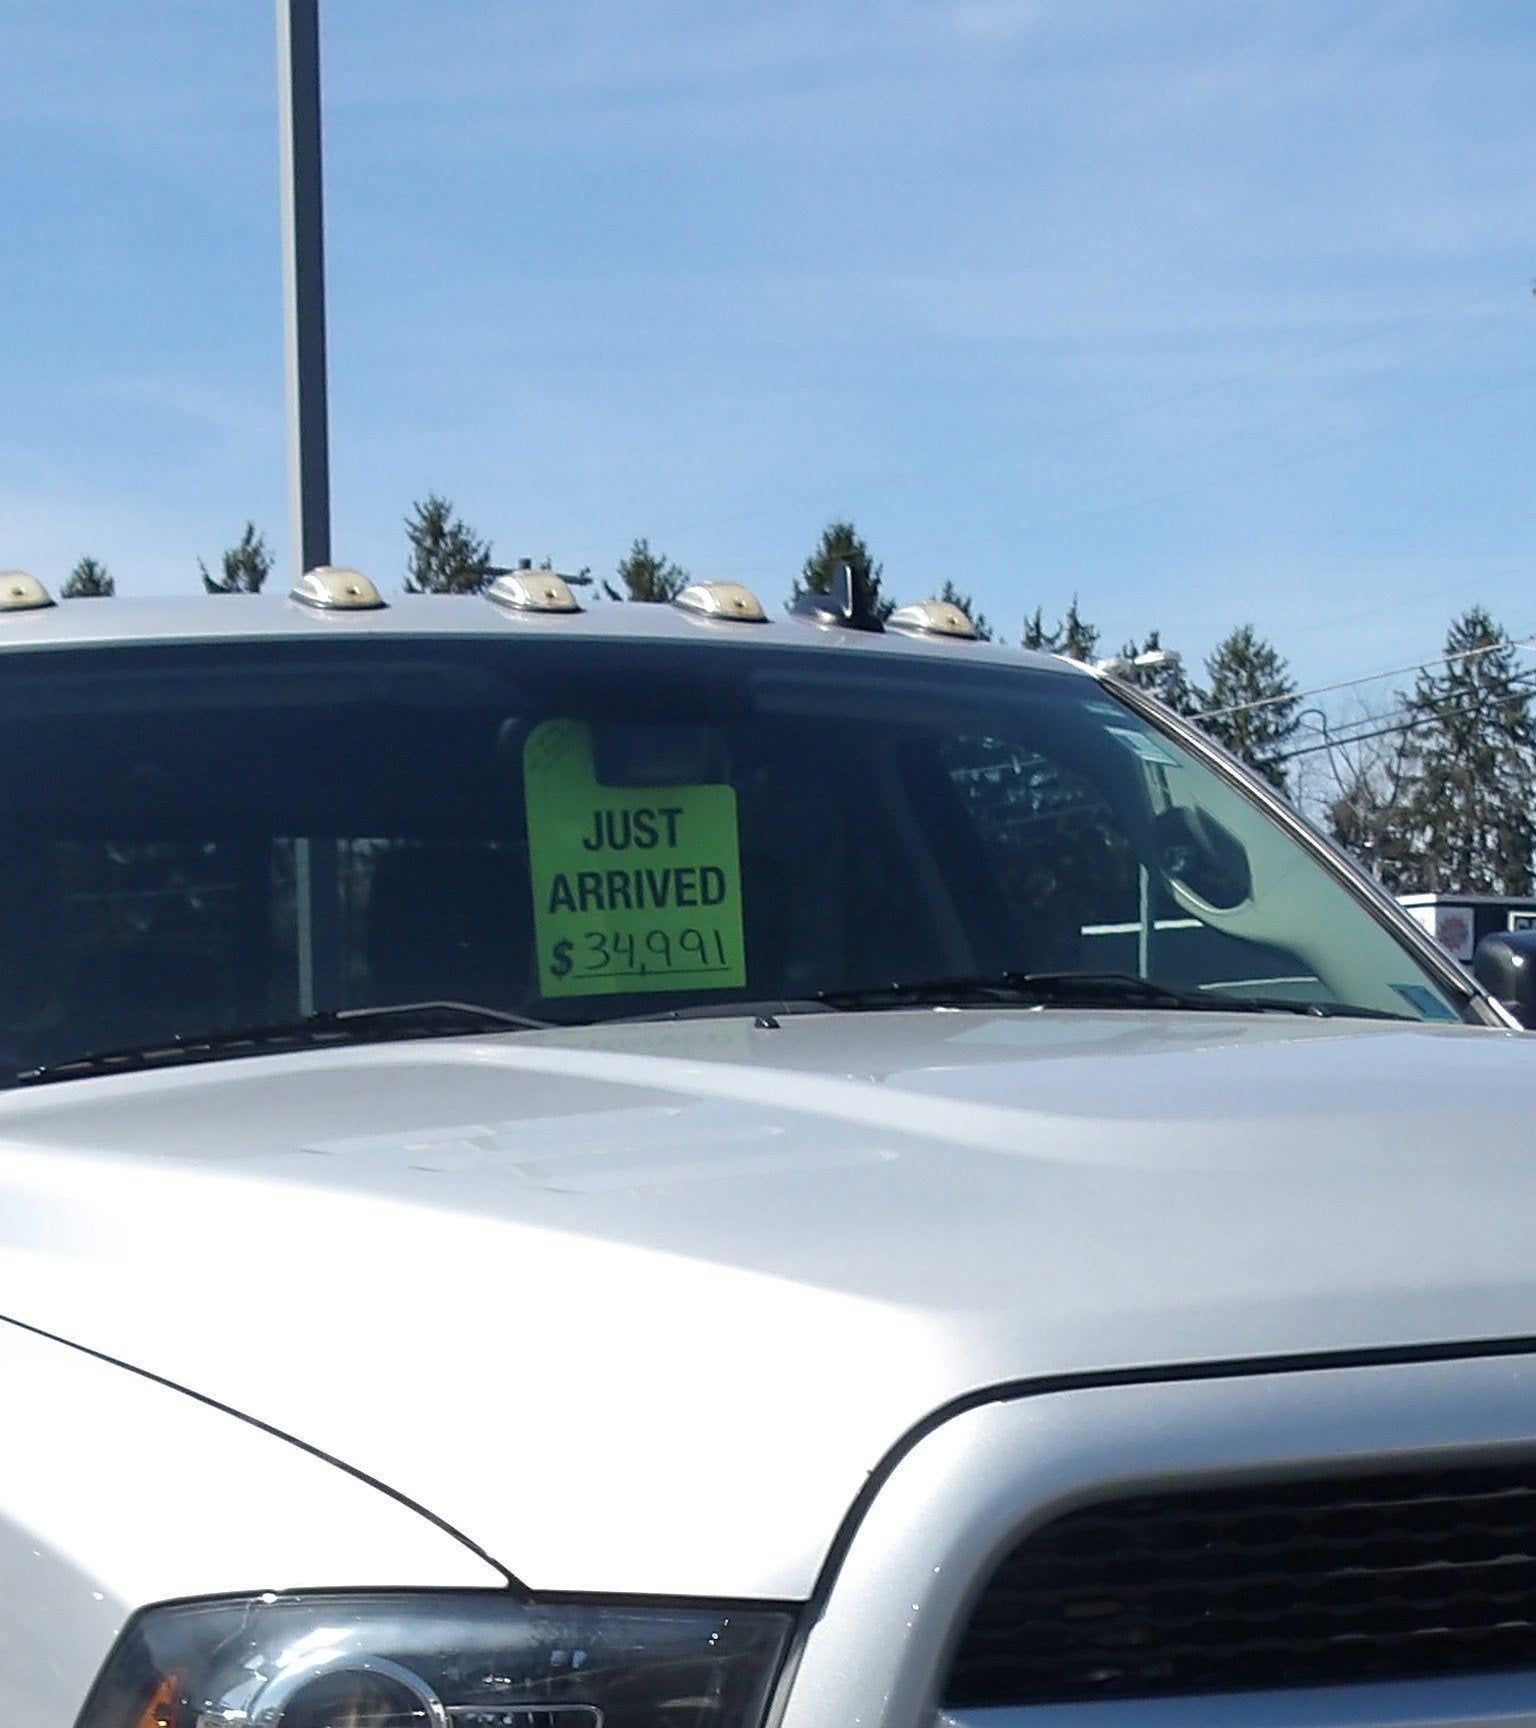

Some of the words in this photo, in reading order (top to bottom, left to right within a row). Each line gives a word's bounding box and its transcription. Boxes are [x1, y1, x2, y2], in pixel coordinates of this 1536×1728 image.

[581, 806, 684, 852] JUST
[547, 866, 727, 914] ARRIVED
[549, 928, 727, 980] $34,991
